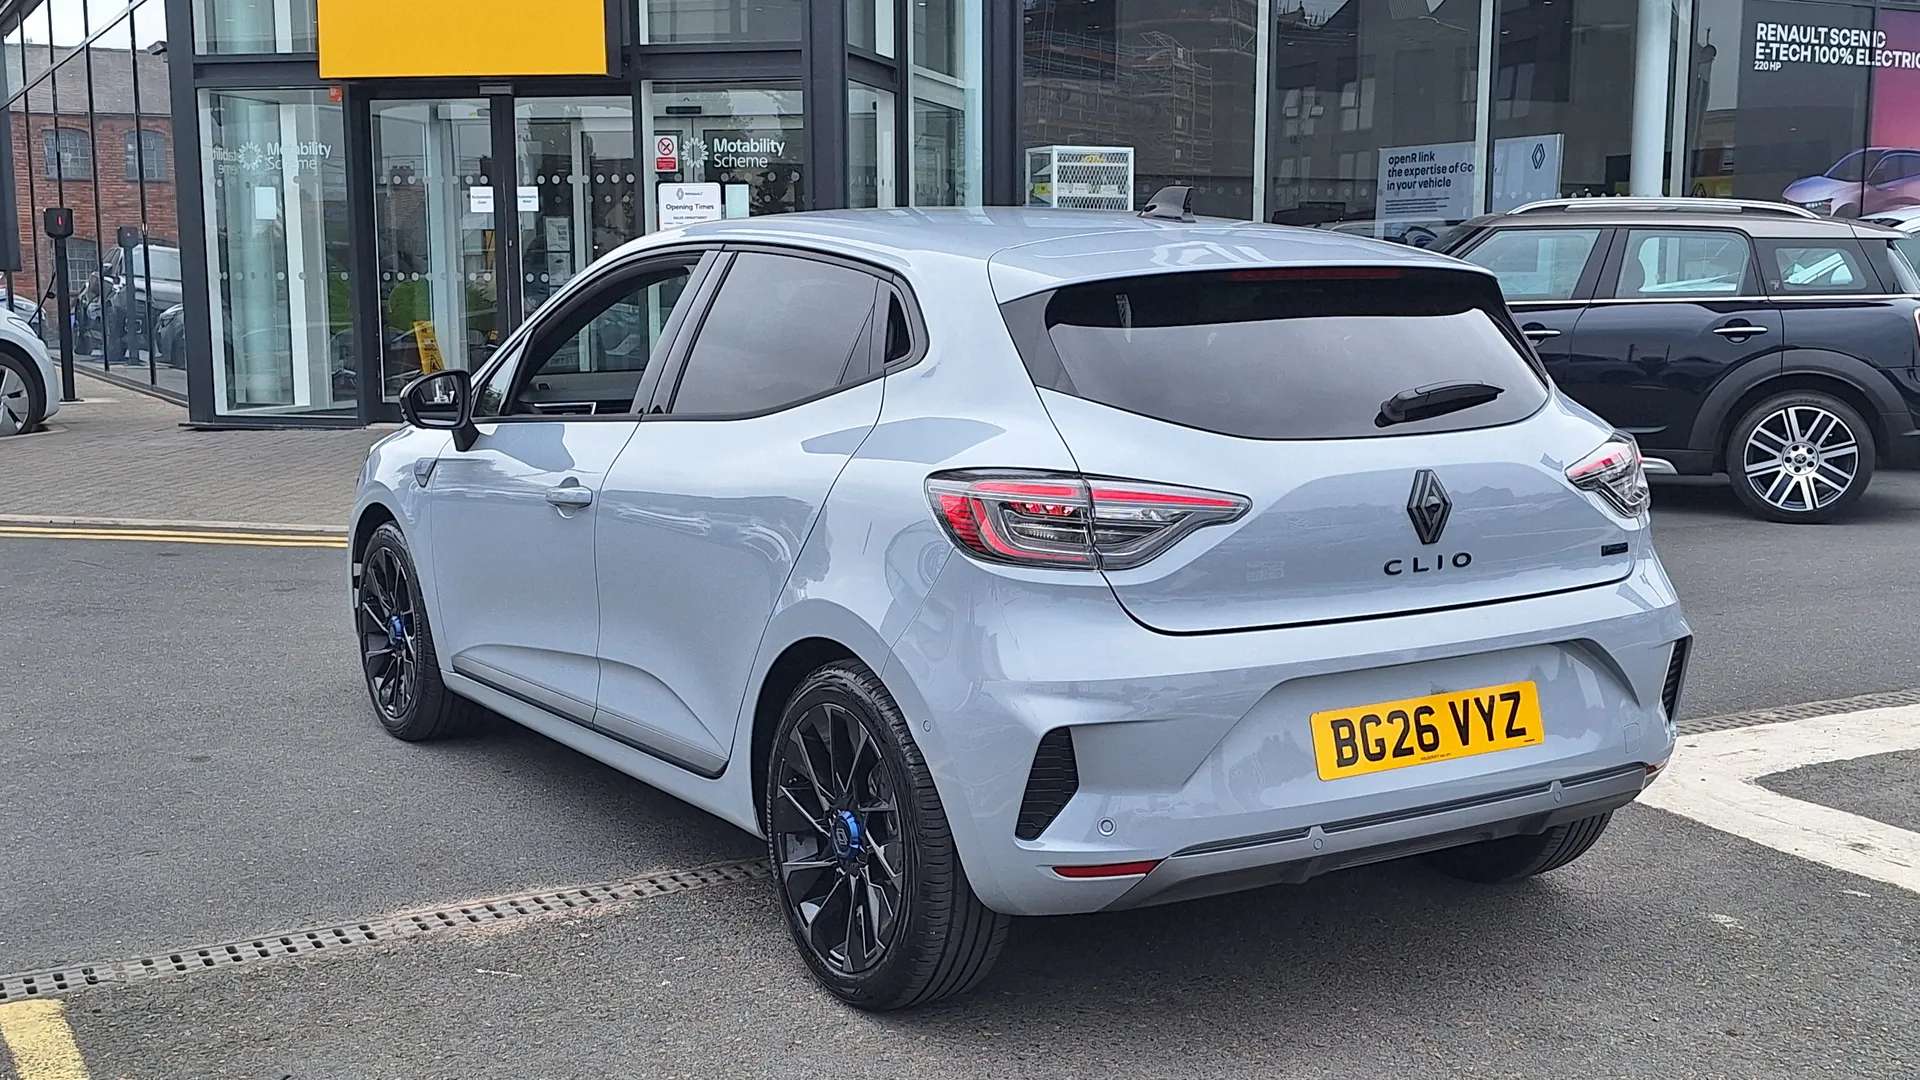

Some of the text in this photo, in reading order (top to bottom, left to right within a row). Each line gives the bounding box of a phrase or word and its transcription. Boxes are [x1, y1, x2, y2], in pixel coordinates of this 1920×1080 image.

[1756, 23, 1886, 48] RENAULT SCENIC
[1755, 42, 1811, 63] E-TECH
[1814, 46, 1854, 65] 100%
[1754, 60, 1782, 71] 220 HP
[713, 138, 785, 156] Motability
[267, 157, 317, 170] Scme
[713, 154, 768, 168] Scheme
[1388, 151, 1435, 167] openR link
[1387, 167, 1402, 178] the
[1404, 164, 1447, 179] expertise
[1448, 162, 1461, 174] of
[1386, 177, 1452, 191] in your vehicle
[665, 203, 693, 211] Opening
[1383, 552, 1472, 576] CLIO
[1331, 691, 1527, 768] BG26 VYZ
